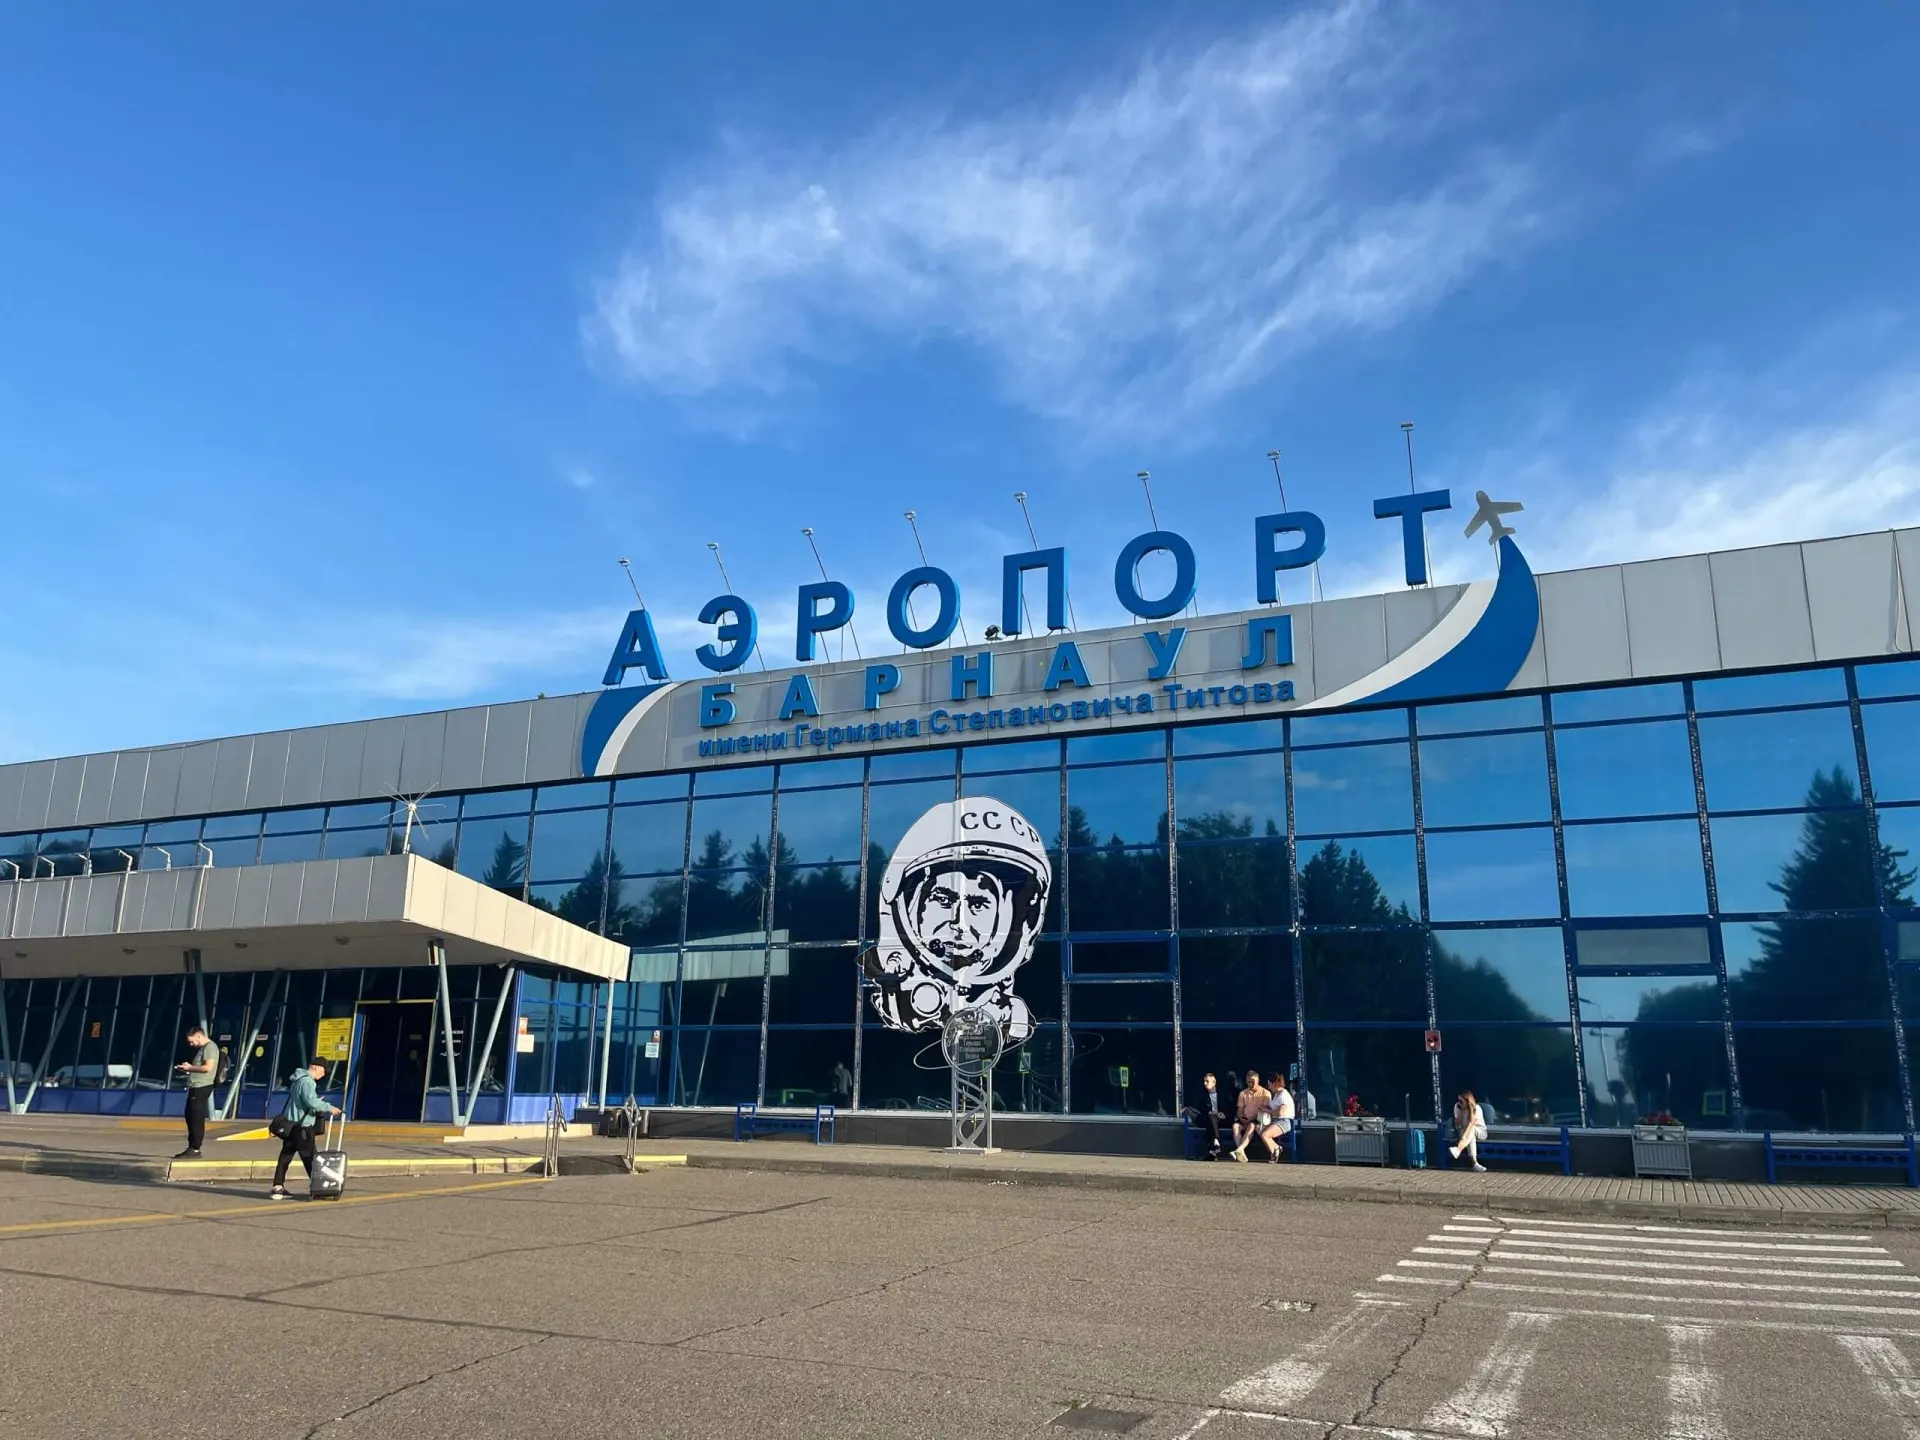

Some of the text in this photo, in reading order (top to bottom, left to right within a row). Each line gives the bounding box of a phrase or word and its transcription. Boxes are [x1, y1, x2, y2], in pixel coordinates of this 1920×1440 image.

[603, 488, 1452, 686] АЭРОПОРТ
[699, 614, 1296, 728] БАРНАУЛ
[699, 680, 1296, 757] имени Германа Степановича Титова
[960, 811, 1040, 844] СССР
